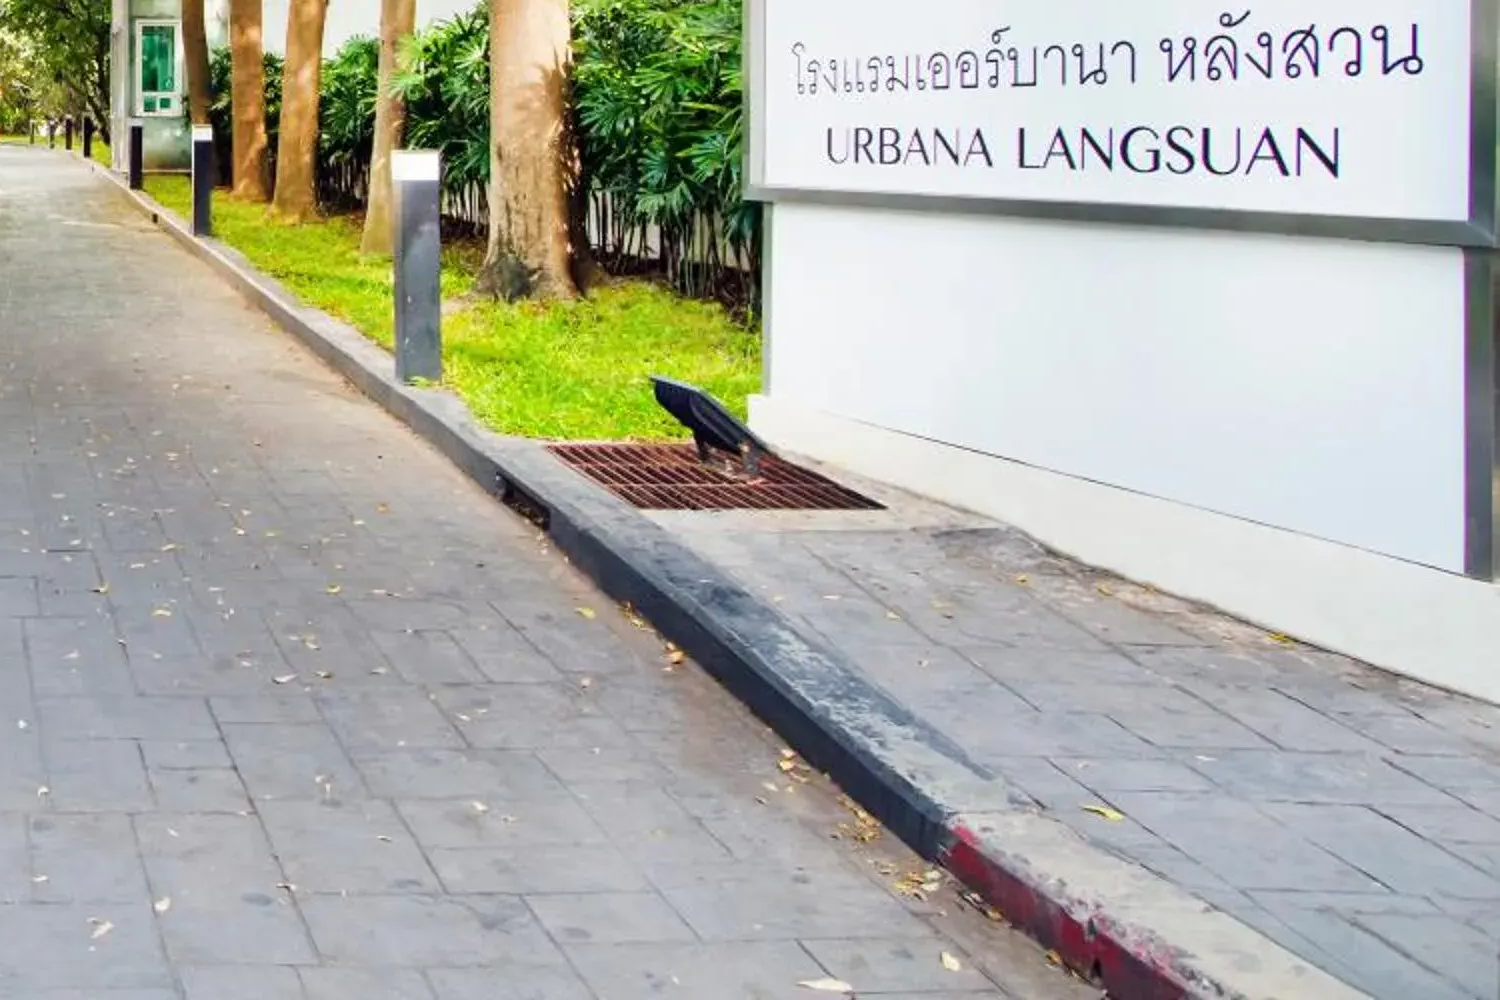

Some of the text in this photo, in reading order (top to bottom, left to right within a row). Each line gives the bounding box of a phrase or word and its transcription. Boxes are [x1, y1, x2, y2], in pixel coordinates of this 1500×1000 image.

[791, 10, 1424, 95] โรงแรมเออร์บานา หลังสวน
[826, 126, 1341, 179] URBANA LANGSUAN
